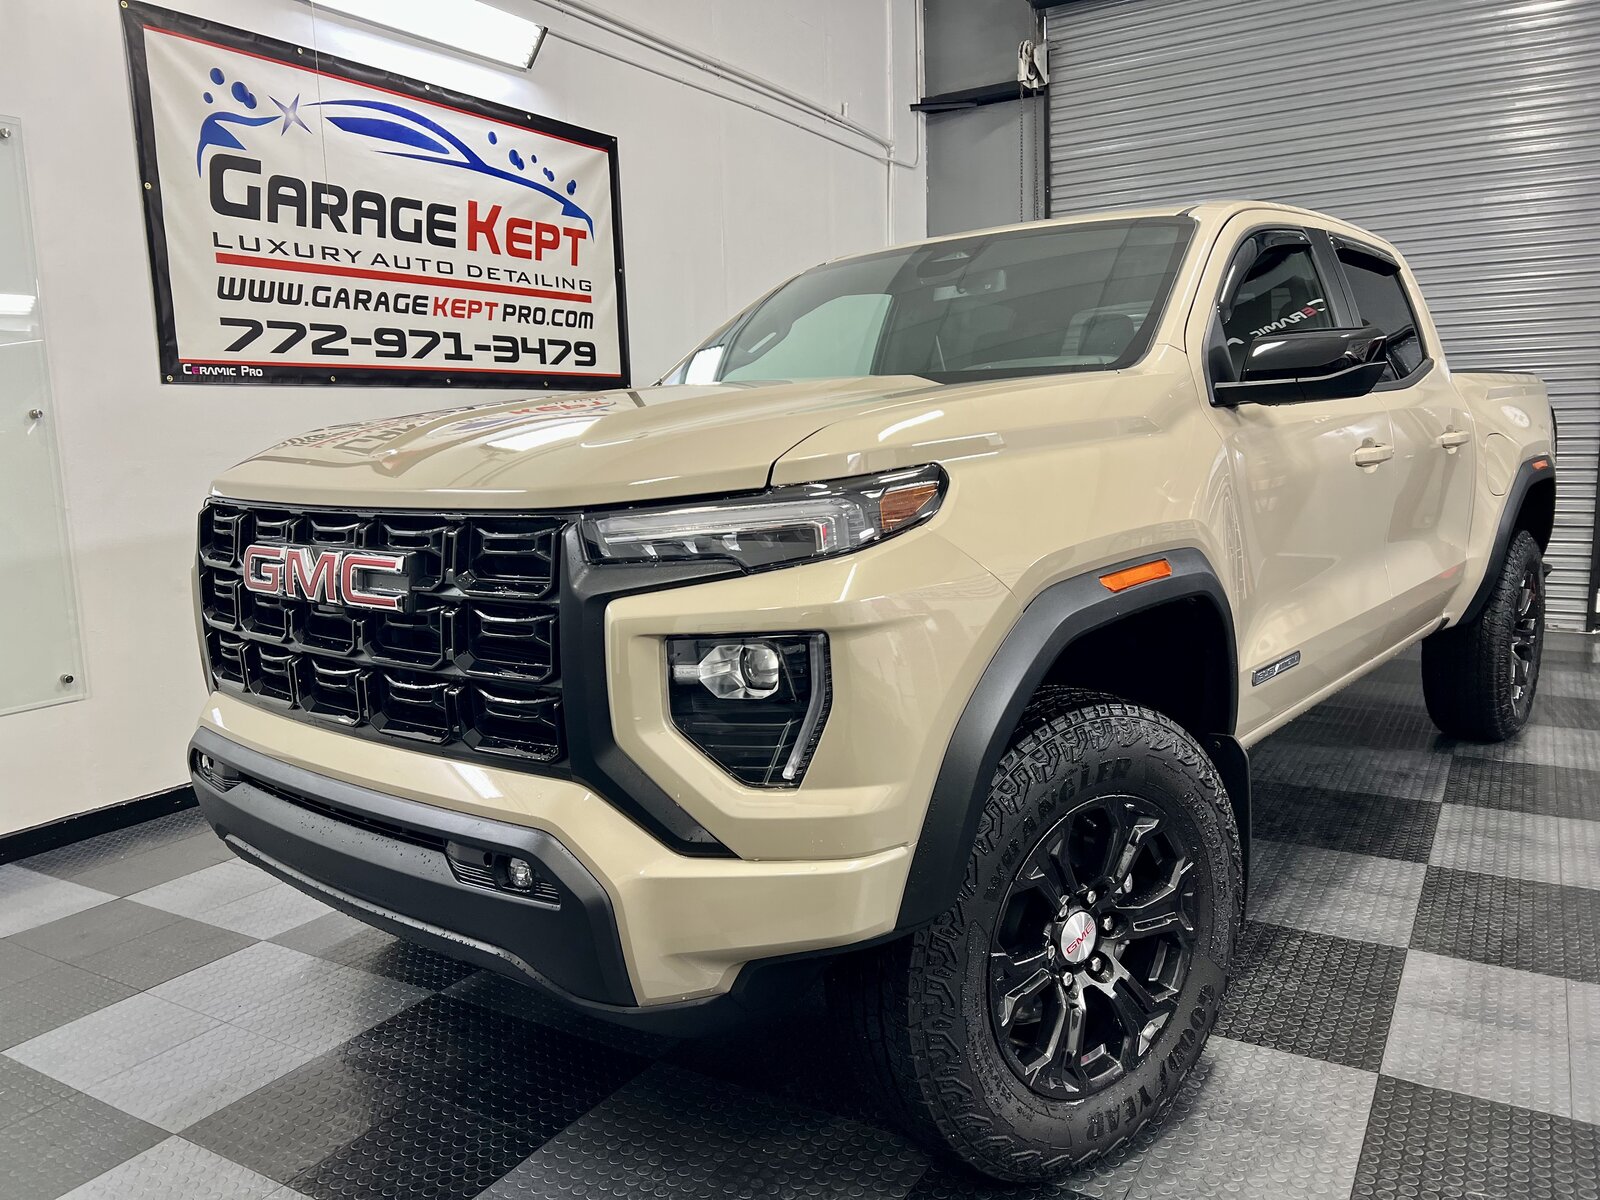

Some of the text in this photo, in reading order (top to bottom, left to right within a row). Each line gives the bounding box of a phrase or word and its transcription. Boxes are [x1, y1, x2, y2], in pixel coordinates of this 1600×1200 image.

[209, 153, 588, 266] GARAGE KEPT
[213, 231, 592, 292] LUXURY AUTO DETAILING
[219, 317, 597, 367] 772-971-3479
[182, 363, 264, 377] CERAMIC PRO
[243, 544, 405, 612] GMC
[1066, 920, 1094, 955] GMC
